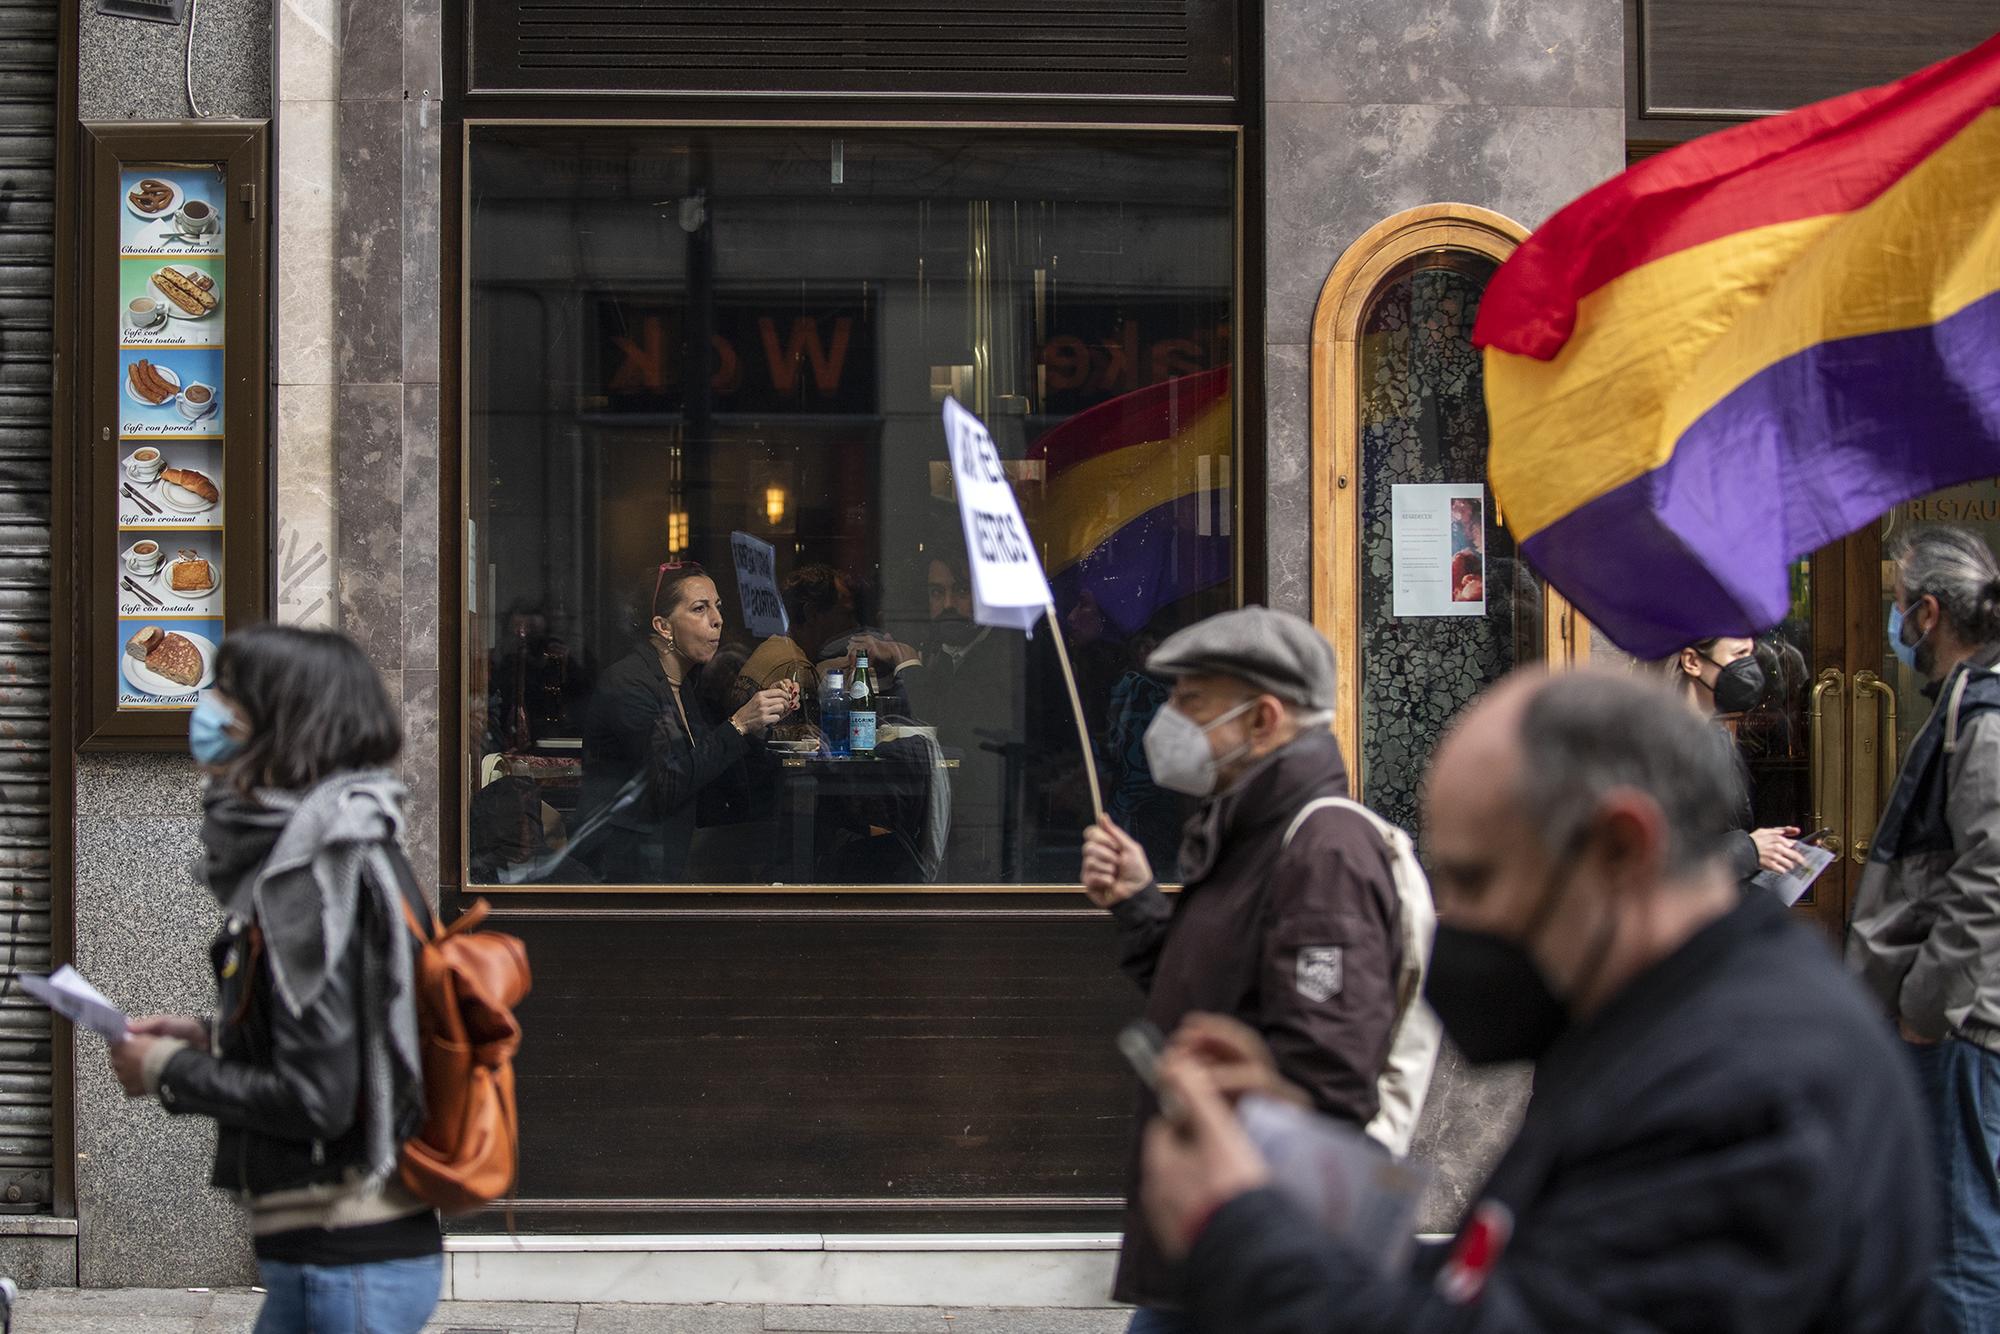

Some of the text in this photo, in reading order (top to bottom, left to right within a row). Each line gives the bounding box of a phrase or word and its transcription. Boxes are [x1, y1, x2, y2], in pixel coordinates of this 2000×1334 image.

[121, 245, 164, 254] Chocolate
[184, 245, 219, 254] churros
[122, 336, 186, 344] barrita tostada
[161, 424, 194, 434] porras
[158, 515, 196, 523] croissant
[160, 604, 195, 612] tostada
[120, 694, 200, 704] Pincho de tortilla
